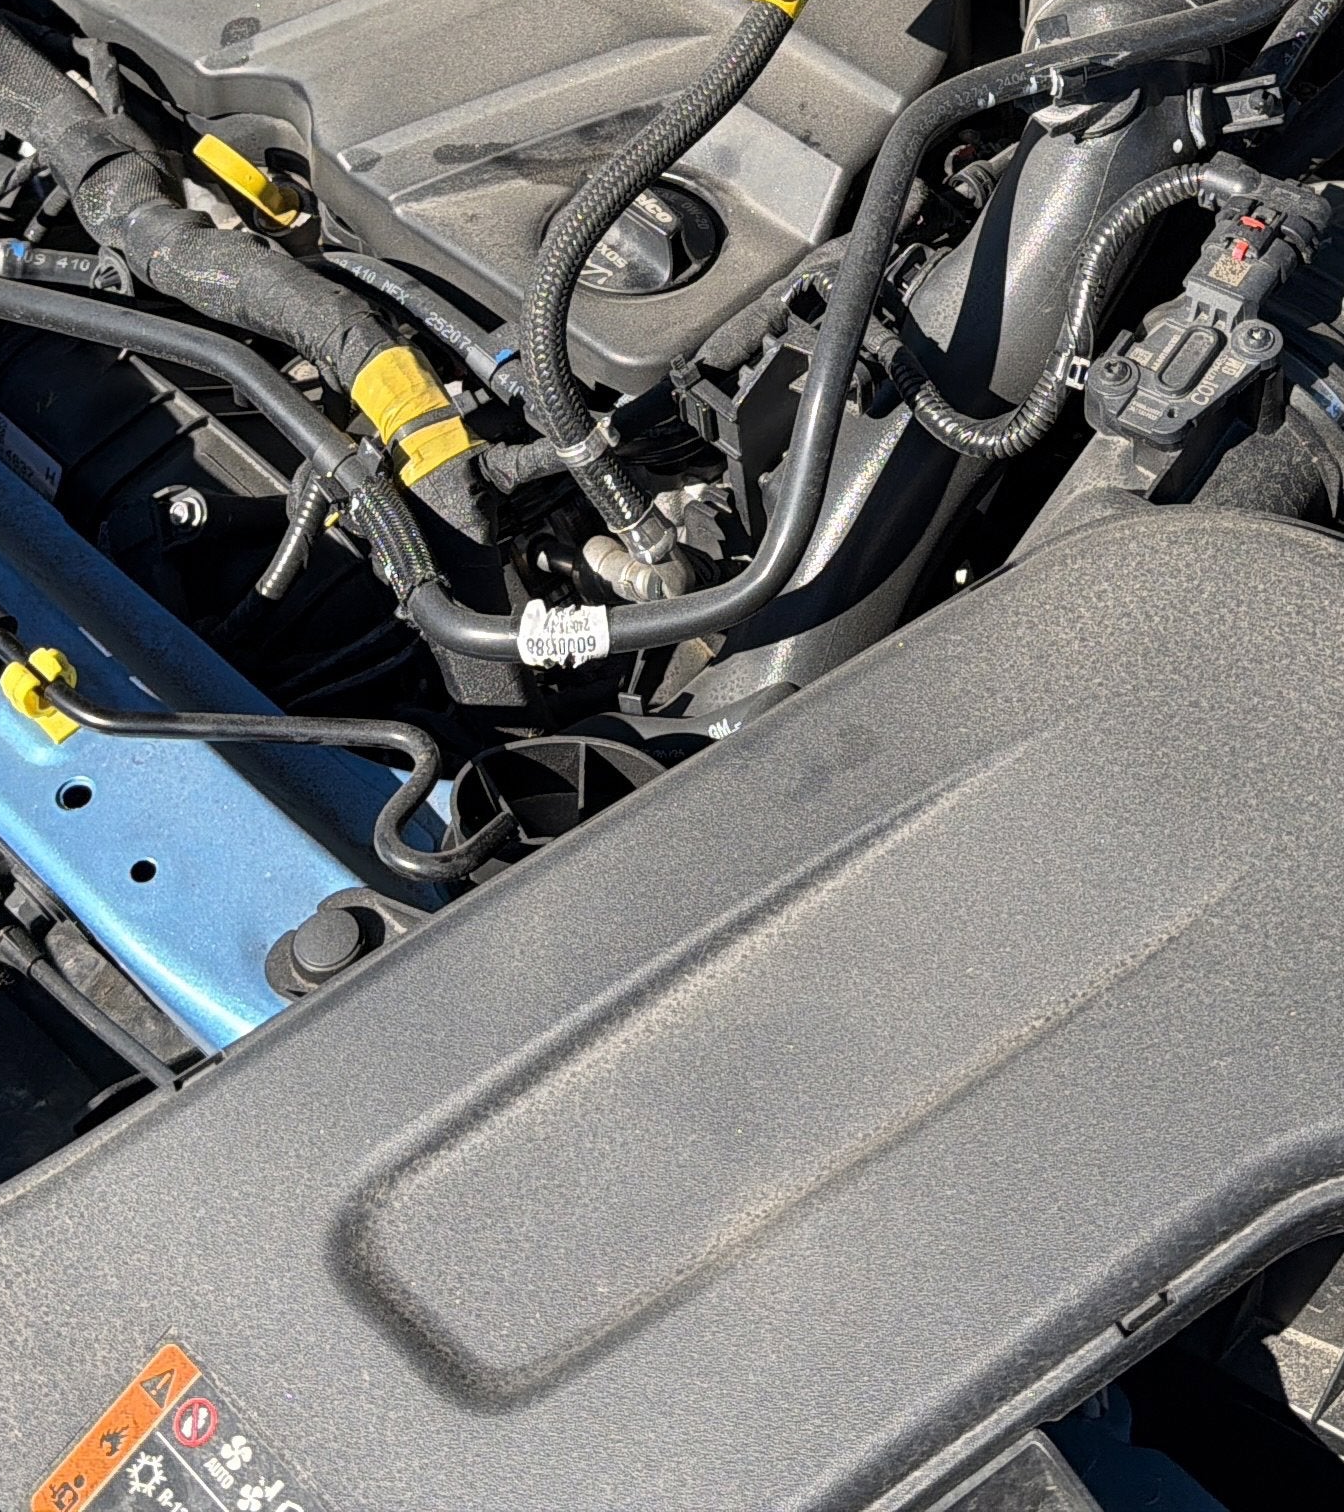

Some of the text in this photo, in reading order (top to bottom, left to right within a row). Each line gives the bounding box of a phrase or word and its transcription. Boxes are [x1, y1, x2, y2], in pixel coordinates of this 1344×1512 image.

[635, 193, 673, 223] elco
[55, 256, 91, 272] 410
[597, 242, 628, 269] xos
[351, 263, 376, 285] 410
[380, 279, 410, 306] MEX
[203, 1457, 235, 1490] AUTO
